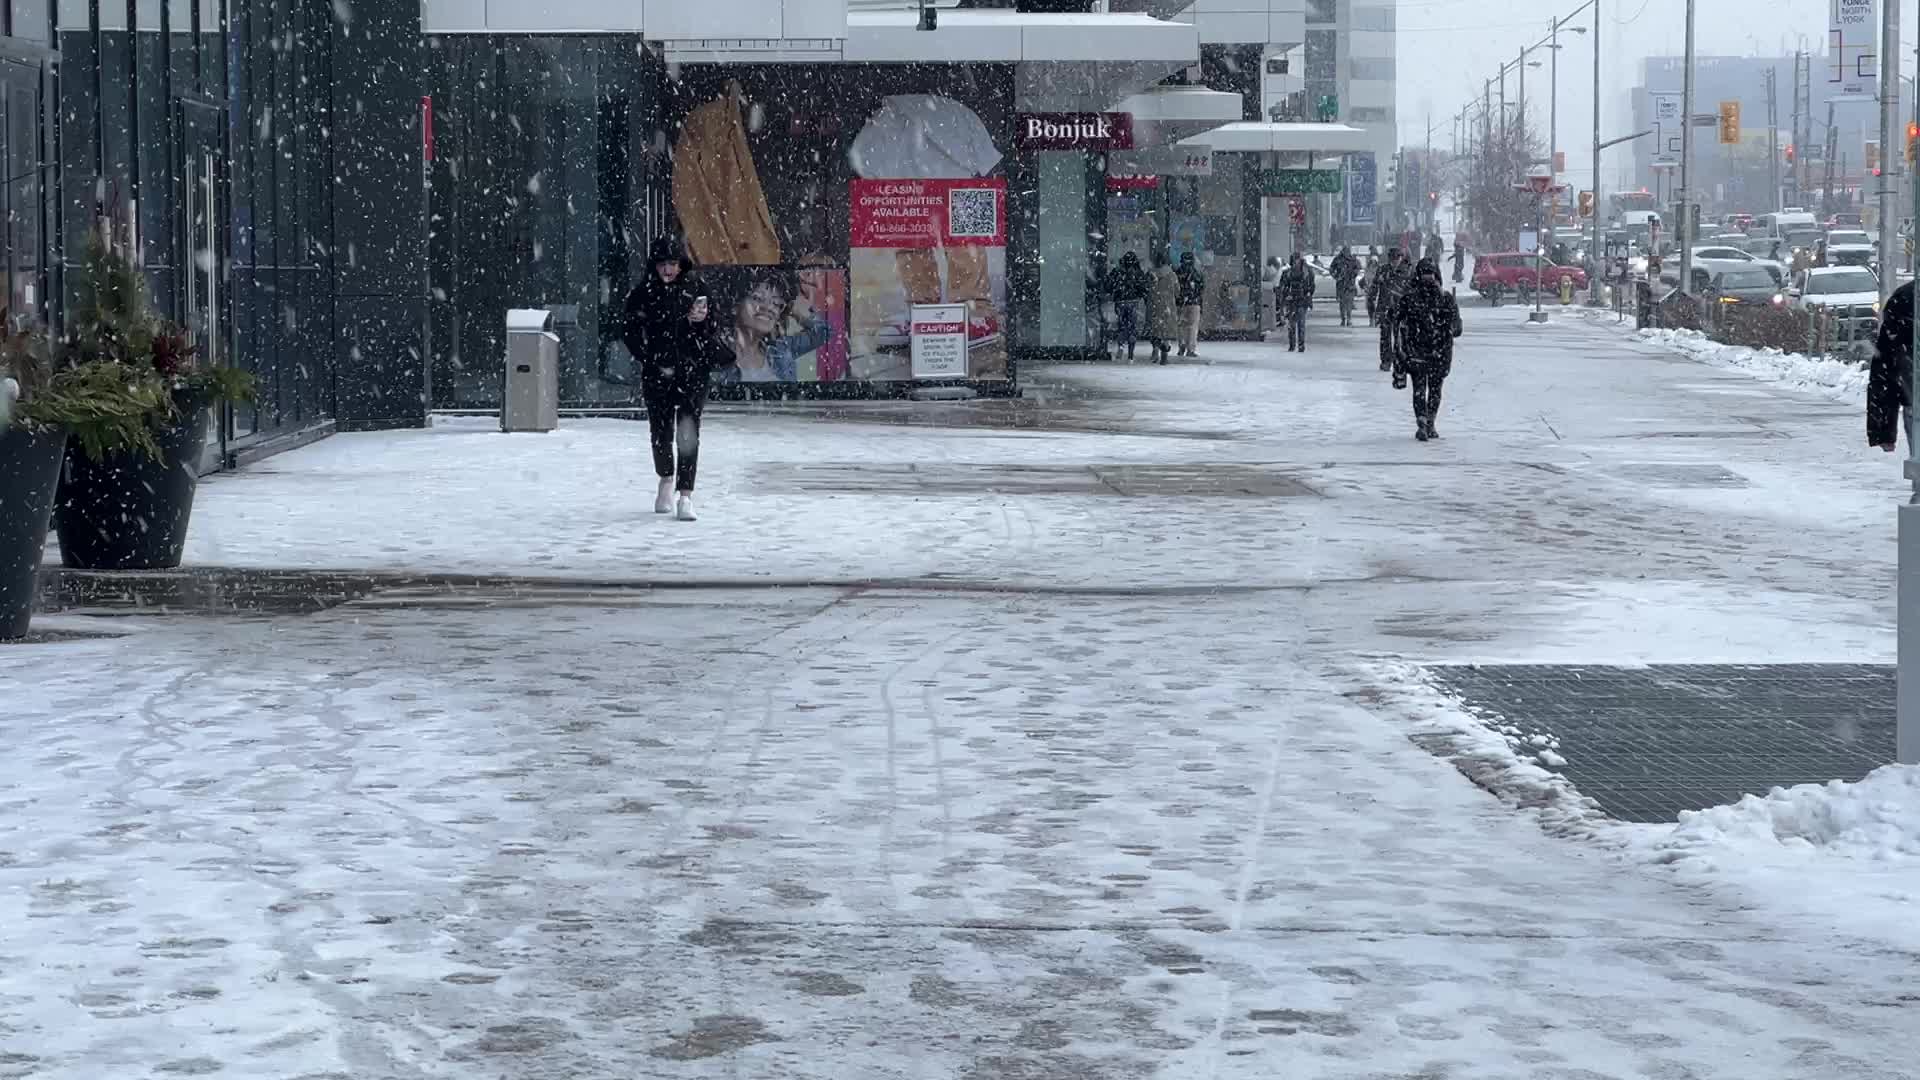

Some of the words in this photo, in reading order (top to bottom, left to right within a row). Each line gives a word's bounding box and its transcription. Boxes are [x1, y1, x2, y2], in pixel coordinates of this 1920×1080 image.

[1842, 6, 1872, 15] NORTH
[1842, 15, 1865, 24] YORK
[1027, 116, 1112, 145] Bonjuk
[878, 184, 925, 194] LEASING
[859, 196, 944, 206] OPPORTUNITIES
[872, 208, 930, 217] AVAILABLE
[920, 324, 959, 333] CAUTION
